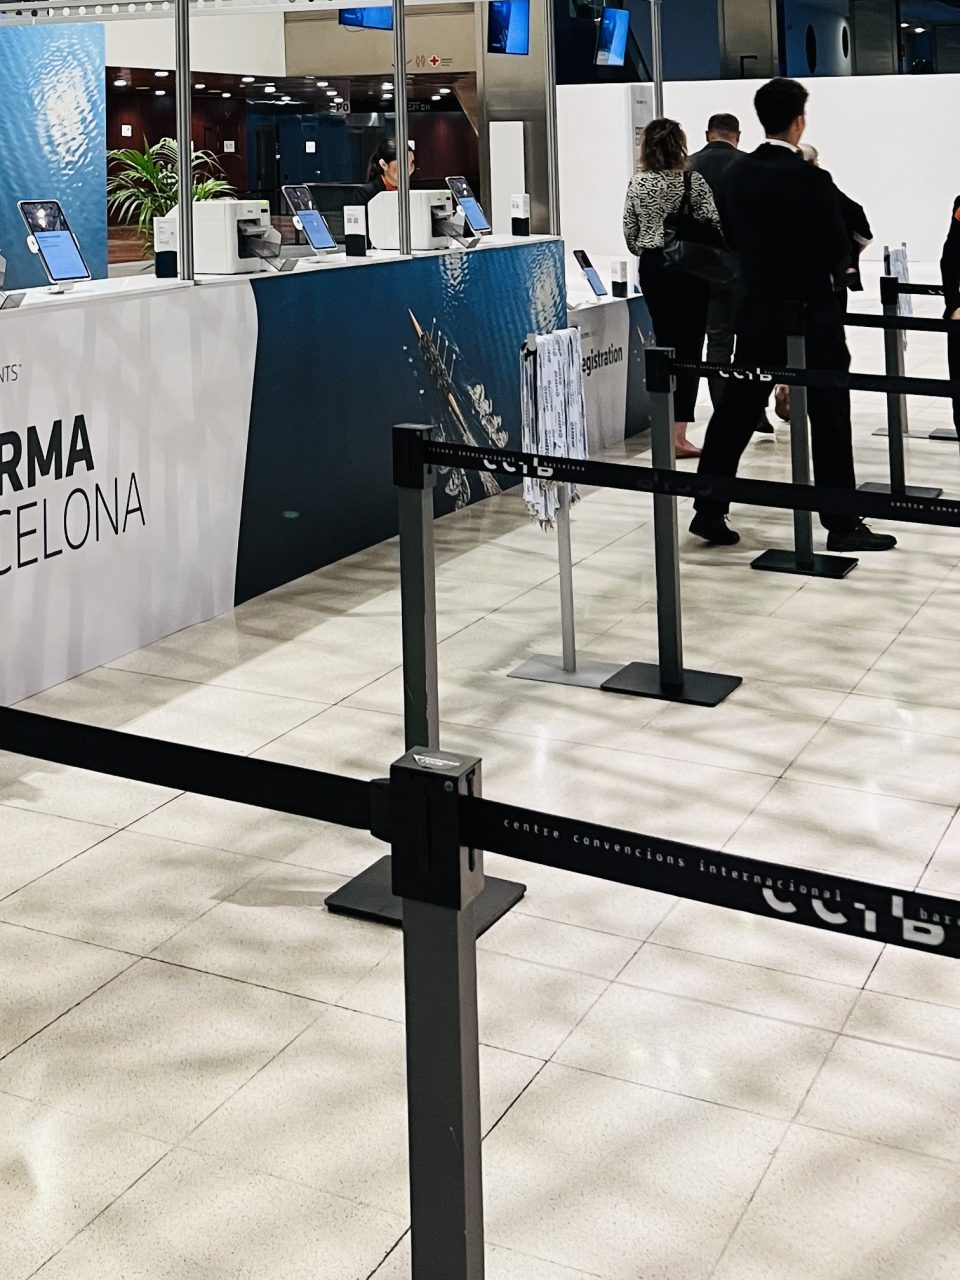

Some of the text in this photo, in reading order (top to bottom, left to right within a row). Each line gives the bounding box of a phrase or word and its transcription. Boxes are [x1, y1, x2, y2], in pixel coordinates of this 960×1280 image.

[581, 343, 623, 377] egistration
[503, 819, 842, 902] centre convencions internacional
[919, 906, 960, 927] bar
